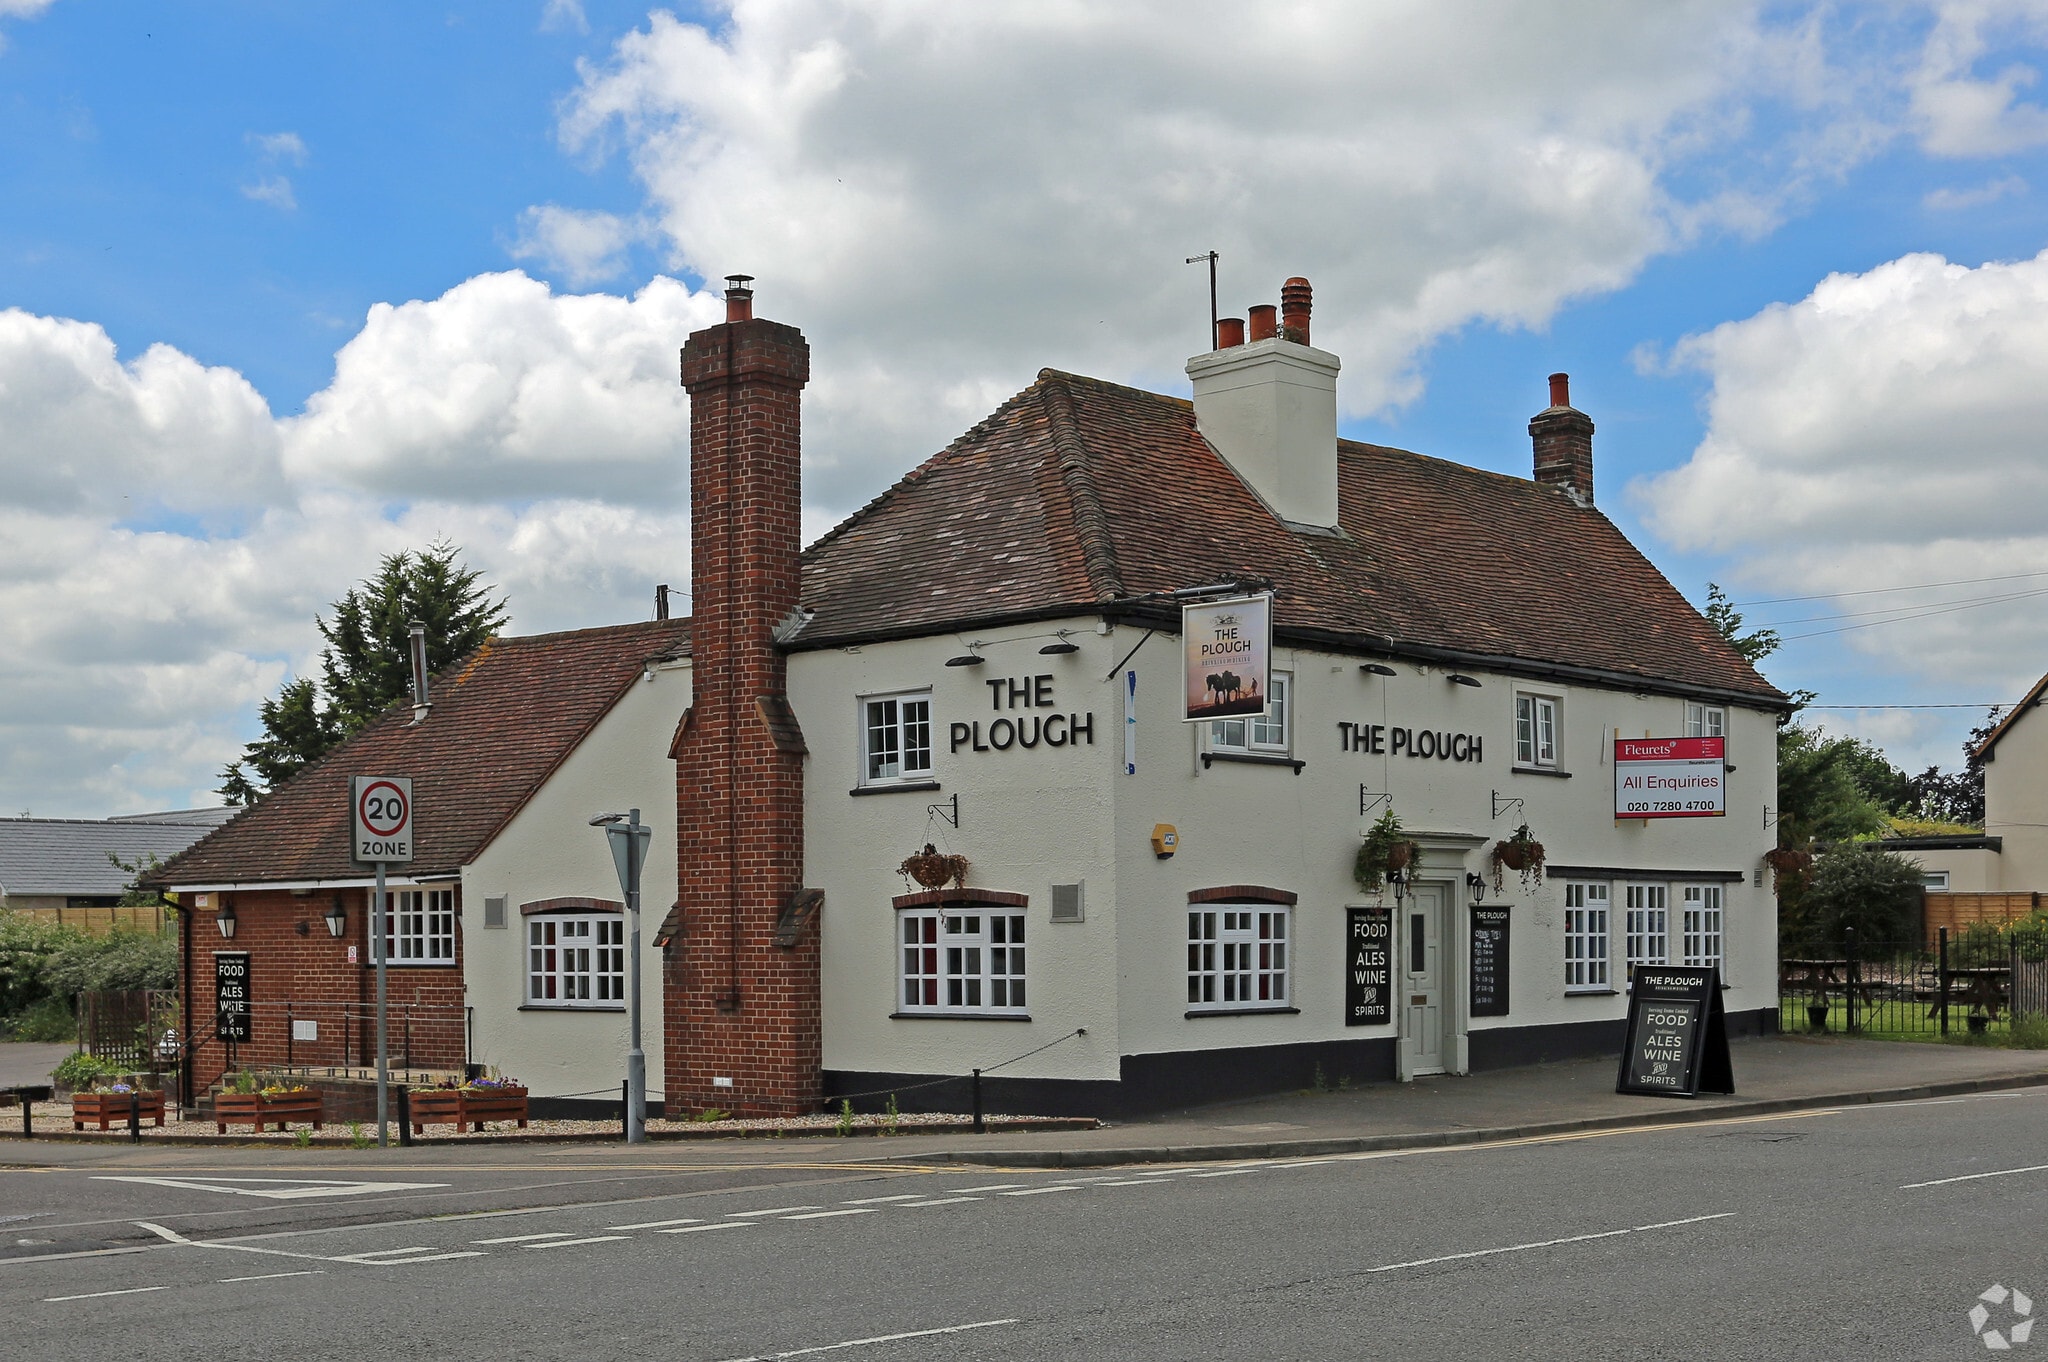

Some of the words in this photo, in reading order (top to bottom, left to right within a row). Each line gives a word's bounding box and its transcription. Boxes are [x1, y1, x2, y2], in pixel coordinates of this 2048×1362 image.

[1215, 628, 1238, 640] THE
[1202, 640, 1251, 655] PLOUGH
[986, 674, 1053, 710] THE
[950, 712, 1093, 753] PLOUGH
[1338, 721, 1385, 754] THE
[1391, 727, 1483, 763] PLOUGH
[1625, 744, 1671, 755] Fleurets
[1623, 776, 1642, 789] All
[1647, 775, 1719, 791] Enquiries
[368, 797, 403, 821] 20
[1627, 802, 1649, 812] 020
[1653, 801, 1682, 811] 7280
[1686, 800, 1715, 810] 4700
[361, 841, 407, 856] ZONE
[1476, 911, 1487, 919] THE
[1487, 911, 1508, 919] PLOUGH
[1354, 923, 1388, 938] FOOD
[1356, 951, 1386, 966] ALES
[218, 965, 245, 976] FOOD
[1355, 970, 1387, 985] WINE
[1644, 976, 1663, 985] THE
[1664, 977, 1703, 986] PLOUGH
[221, 986, 243, 998] ALES
[1355, 1005, 1385, 1016] SPIRITS
[1646, 1014, 1687, 1026] FOOD
[1646, 1035, 1682, 1047] ALES
[1643, 1049, 1682, 1061] WINE
[1640, 1075, 1676, 1085] SPIRITS
